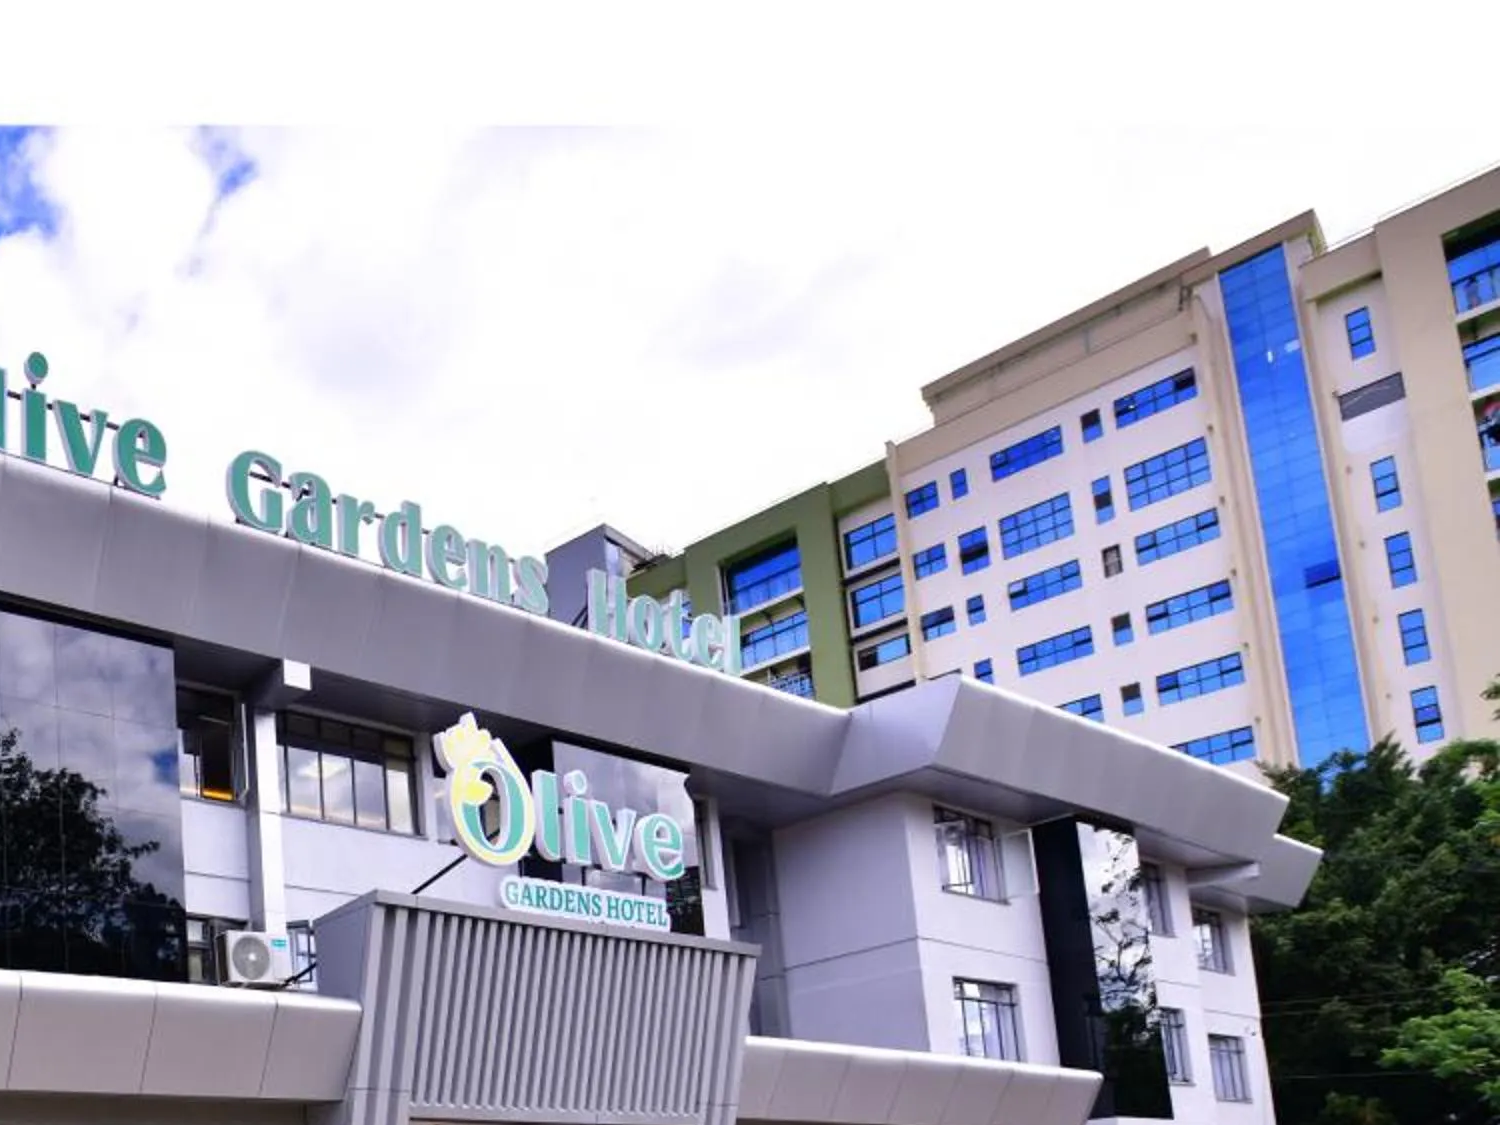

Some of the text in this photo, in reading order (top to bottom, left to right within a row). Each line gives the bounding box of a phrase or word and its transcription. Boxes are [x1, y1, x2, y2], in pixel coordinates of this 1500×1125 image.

[225, 449, 549, 615] Gardens
[585, 567, 742, 677] Hotel
[450, 752, 685, 881] Olive
[504, 881, 668, 926] GARDENS HOTEL
